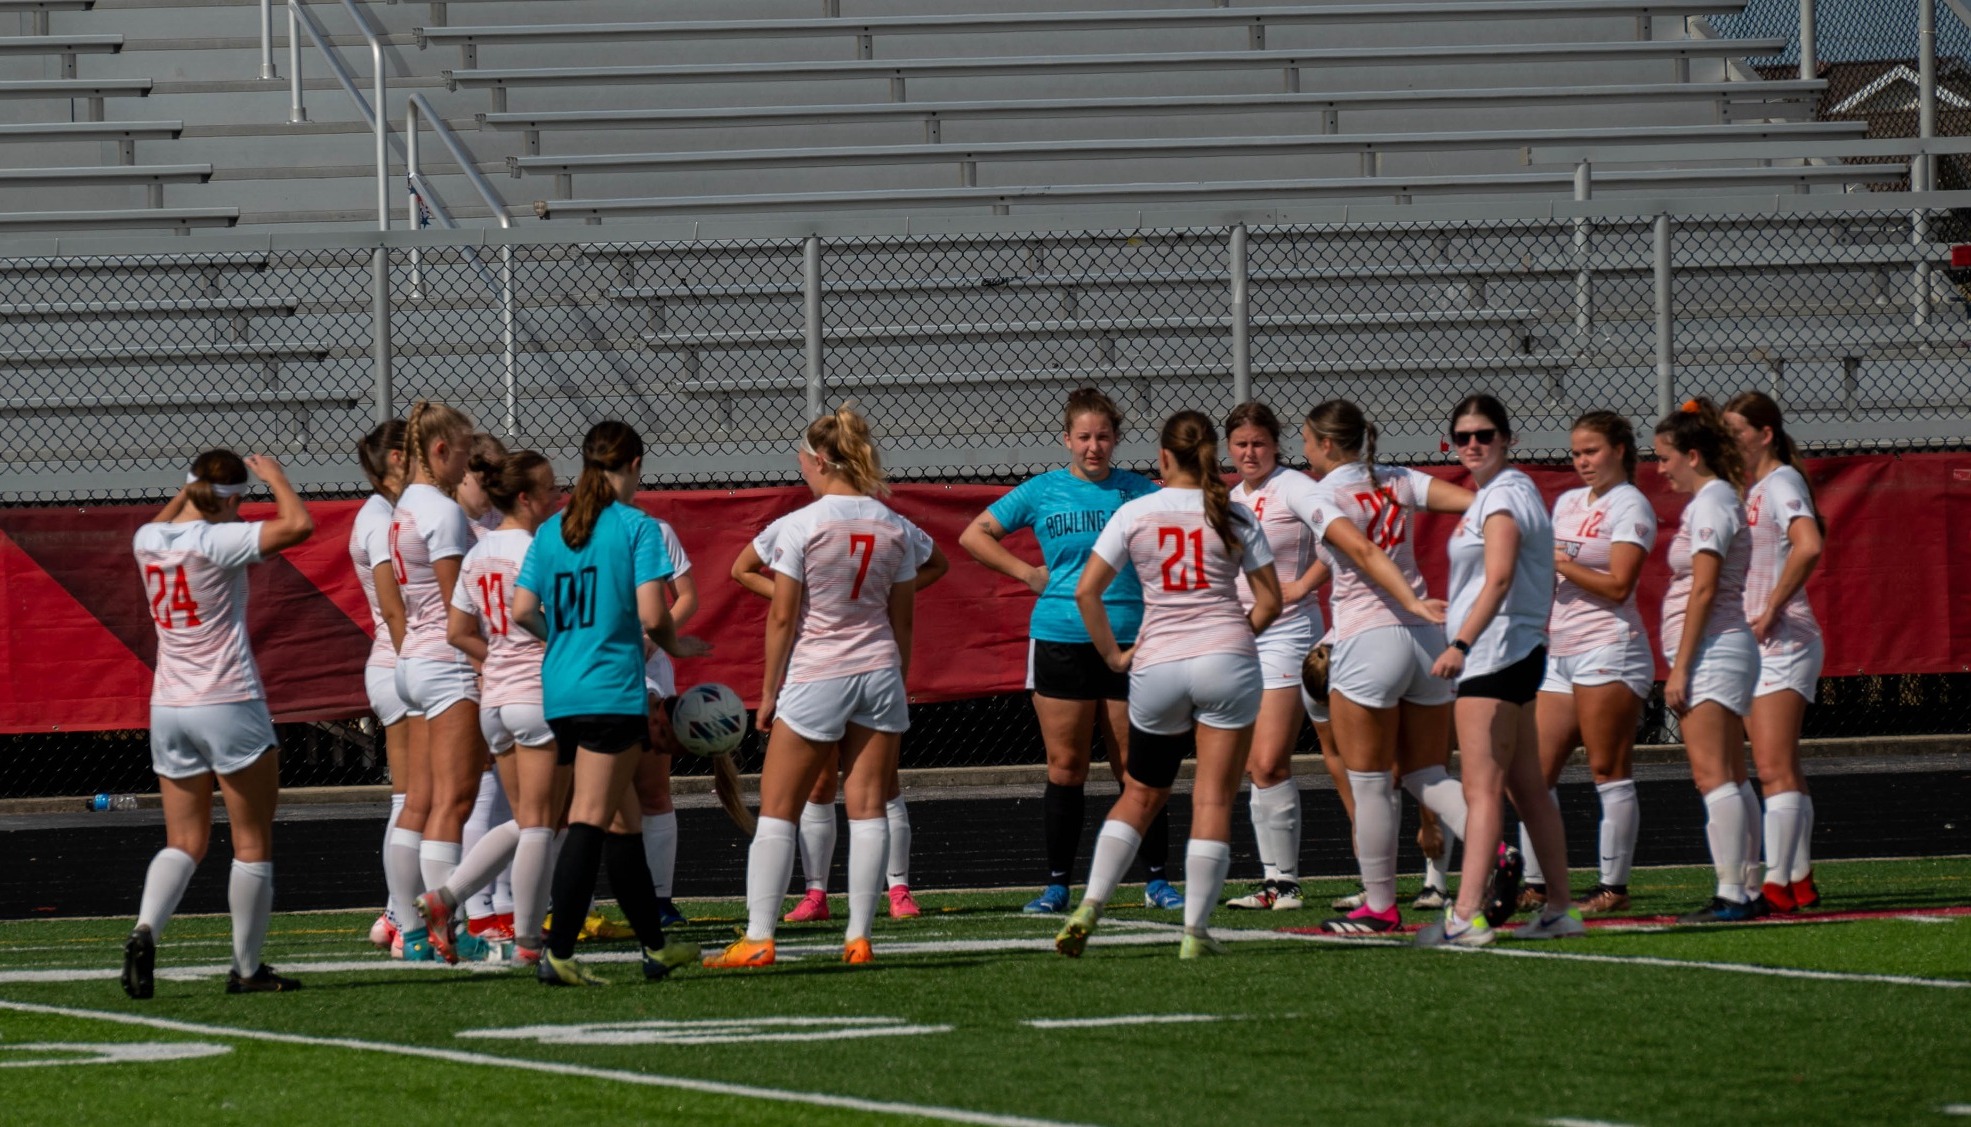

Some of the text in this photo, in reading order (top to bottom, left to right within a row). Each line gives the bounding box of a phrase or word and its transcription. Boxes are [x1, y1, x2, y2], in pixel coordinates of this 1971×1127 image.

[1046, 510, 1105, 540] BOWLING
[1576, 511, 1604, 538] 12
[850, 534, 875, 600] 7
[1158, 526, 1211, 591] 21
[145, 564, 202, 629] 24
